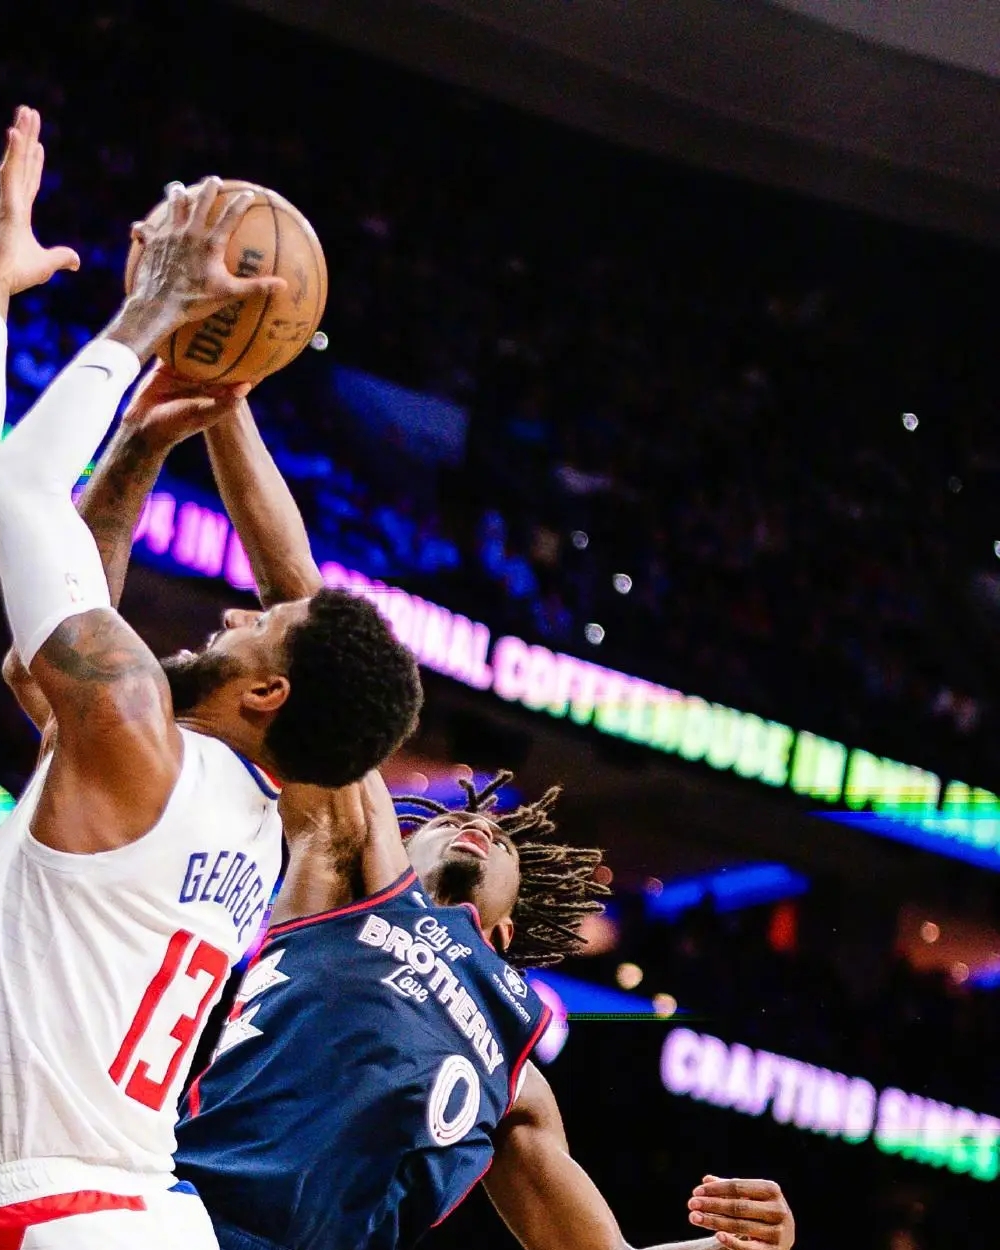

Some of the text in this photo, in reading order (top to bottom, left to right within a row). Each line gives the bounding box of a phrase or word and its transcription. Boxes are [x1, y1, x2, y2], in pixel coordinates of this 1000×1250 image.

[184, 248, 264, 365] Wiln
[492, 634, 795, 788] COFFEEHOUSE
[357, 914, 504, 1075] BROTHERLY
[380, 964, 431, 1004] Love
[414, 915, 473, 962] City of
[107, 928, 231, 1112] 13
[428, 1054, 481, 1147] 0
[660, 1027, 877, 1144] CRAFTING
